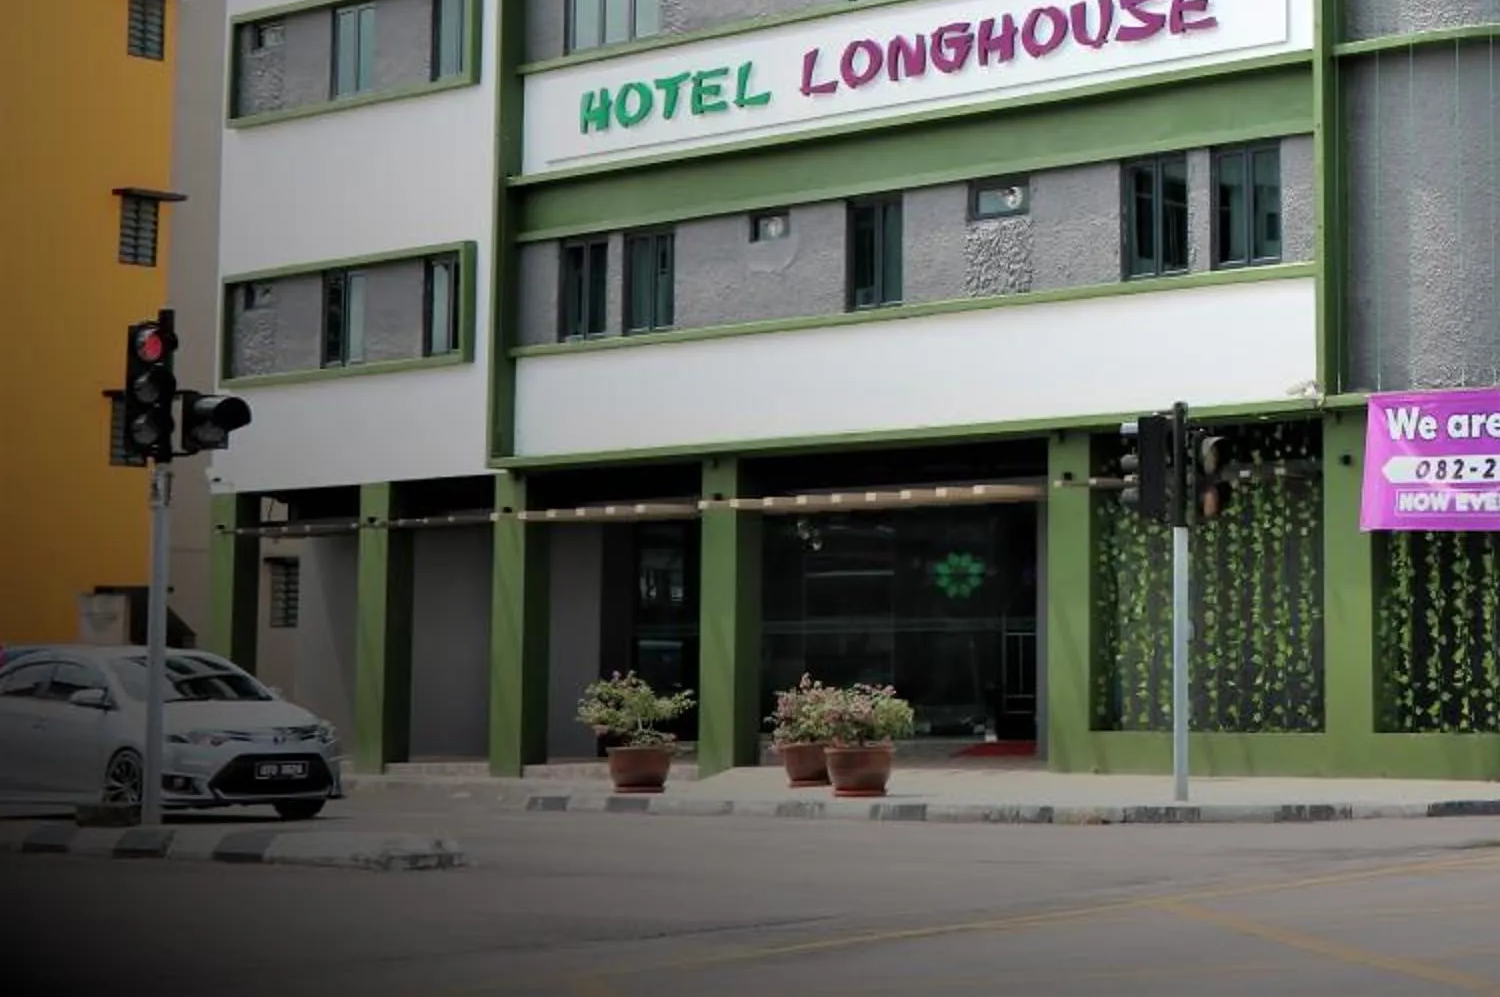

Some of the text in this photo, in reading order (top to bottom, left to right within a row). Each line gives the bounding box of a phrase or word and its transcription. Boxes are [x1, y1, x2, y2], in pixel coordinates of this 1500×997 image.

[580, 61, 772, 133] HOTEL
[1385, 406, 1437, 440] We
[1399, 491, 1450, 512] NOW
